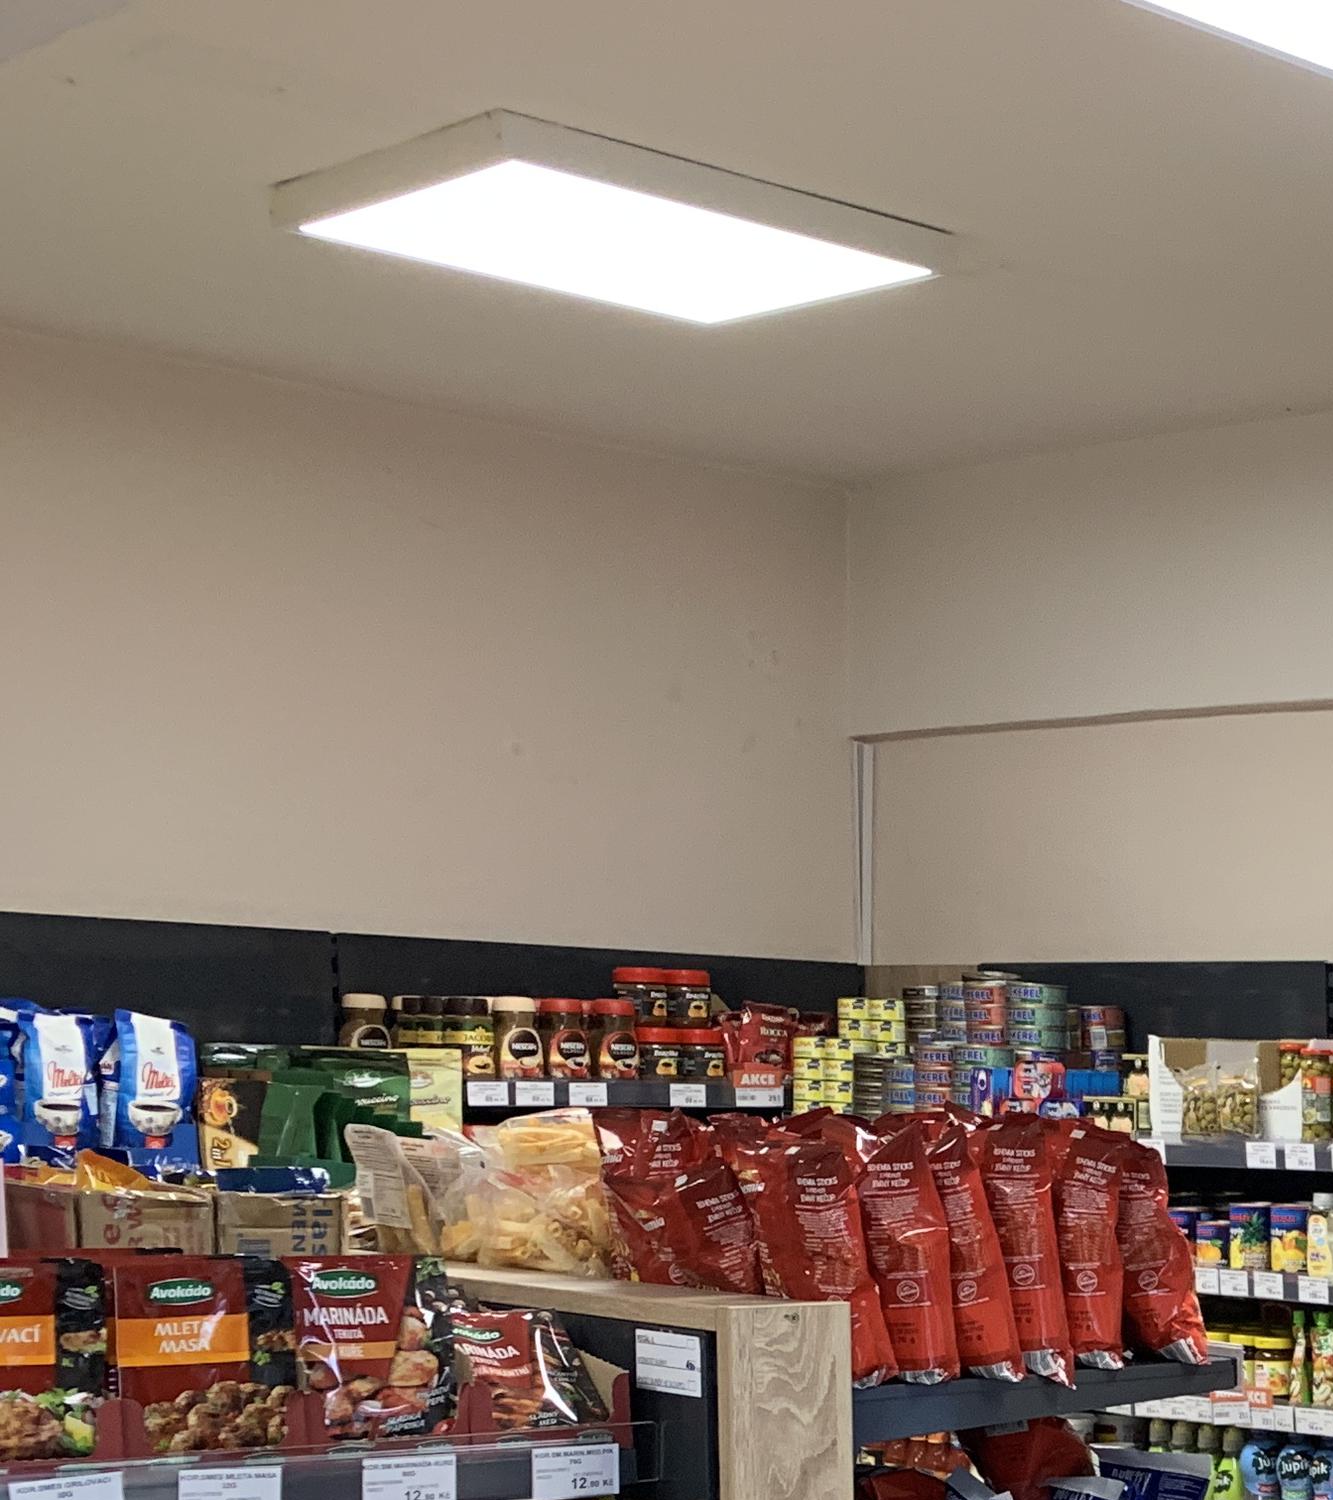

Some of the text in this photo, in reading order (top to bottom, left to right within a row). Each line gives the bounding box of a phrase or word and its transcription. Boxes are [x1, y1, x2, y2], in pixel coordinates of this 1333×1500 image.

[740, 1073, 776, 1086] AKCE
[312, 1277, 375, 1290] Avokádo
[151, 1285, 212, 1300] Avokádo
[303, 1306, 389, 1326] MARINÁDA
